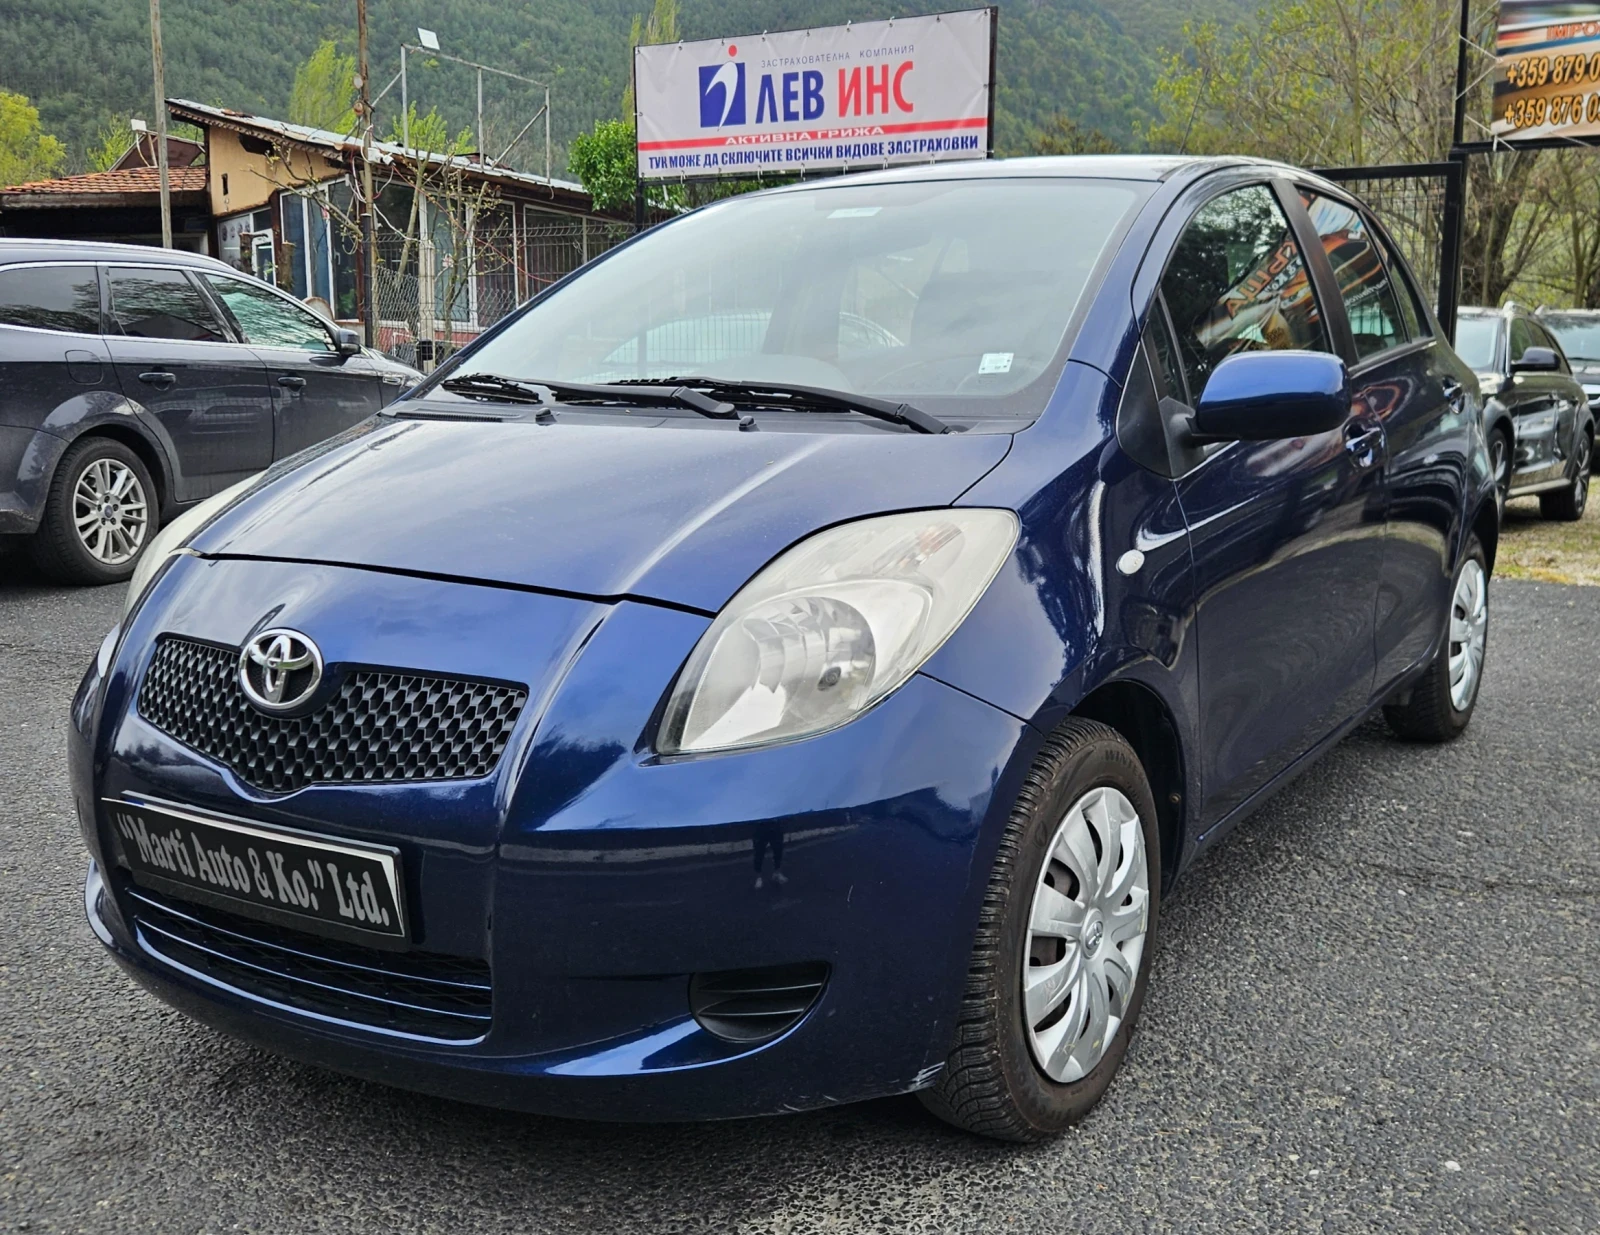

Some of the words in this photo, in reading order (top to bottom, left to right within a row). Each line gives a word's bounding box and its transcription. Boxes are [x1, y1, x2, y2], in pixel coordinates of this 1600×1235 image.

[1546, 20, 1600, 41] IMPO
[761, 51, 850, 68] ЗАСТРАХОВАТЕЛНА
[859, 44, 915, 59] КОМПАНИЯ
[1506, 55, 1549, 88] +359
[1552, 53, 1587, 86] 879
[755, 70, 825, 124] ЛЕВ
[838, 60, 914, 118] ИНС
[1504, 97, 1547, 128] +359
[1550, 93, 1584, 126] 876
[648, 156, 668, 170] ТУК
[669, 154, 701, 169] МОЖЕ
[703, 152, 719, 167] ДА
[721, 148, 783, 166] СКЛЮЧИТЕ
[786, 145, 833, 162] ВСИЧКИ
[836, 141, 885, 160] ВИДОВЕ
[888, 135, 979, 154] ЗАСТРАХОВКИ
[725, 131, 812, 145] АКТИВНА
[817, 126, 885, 140] ГРИЖА
[191, 831, 250, 893] Auto
[248, 847, 275, 900] &
[327, 862, 390, 926] Ltd.
